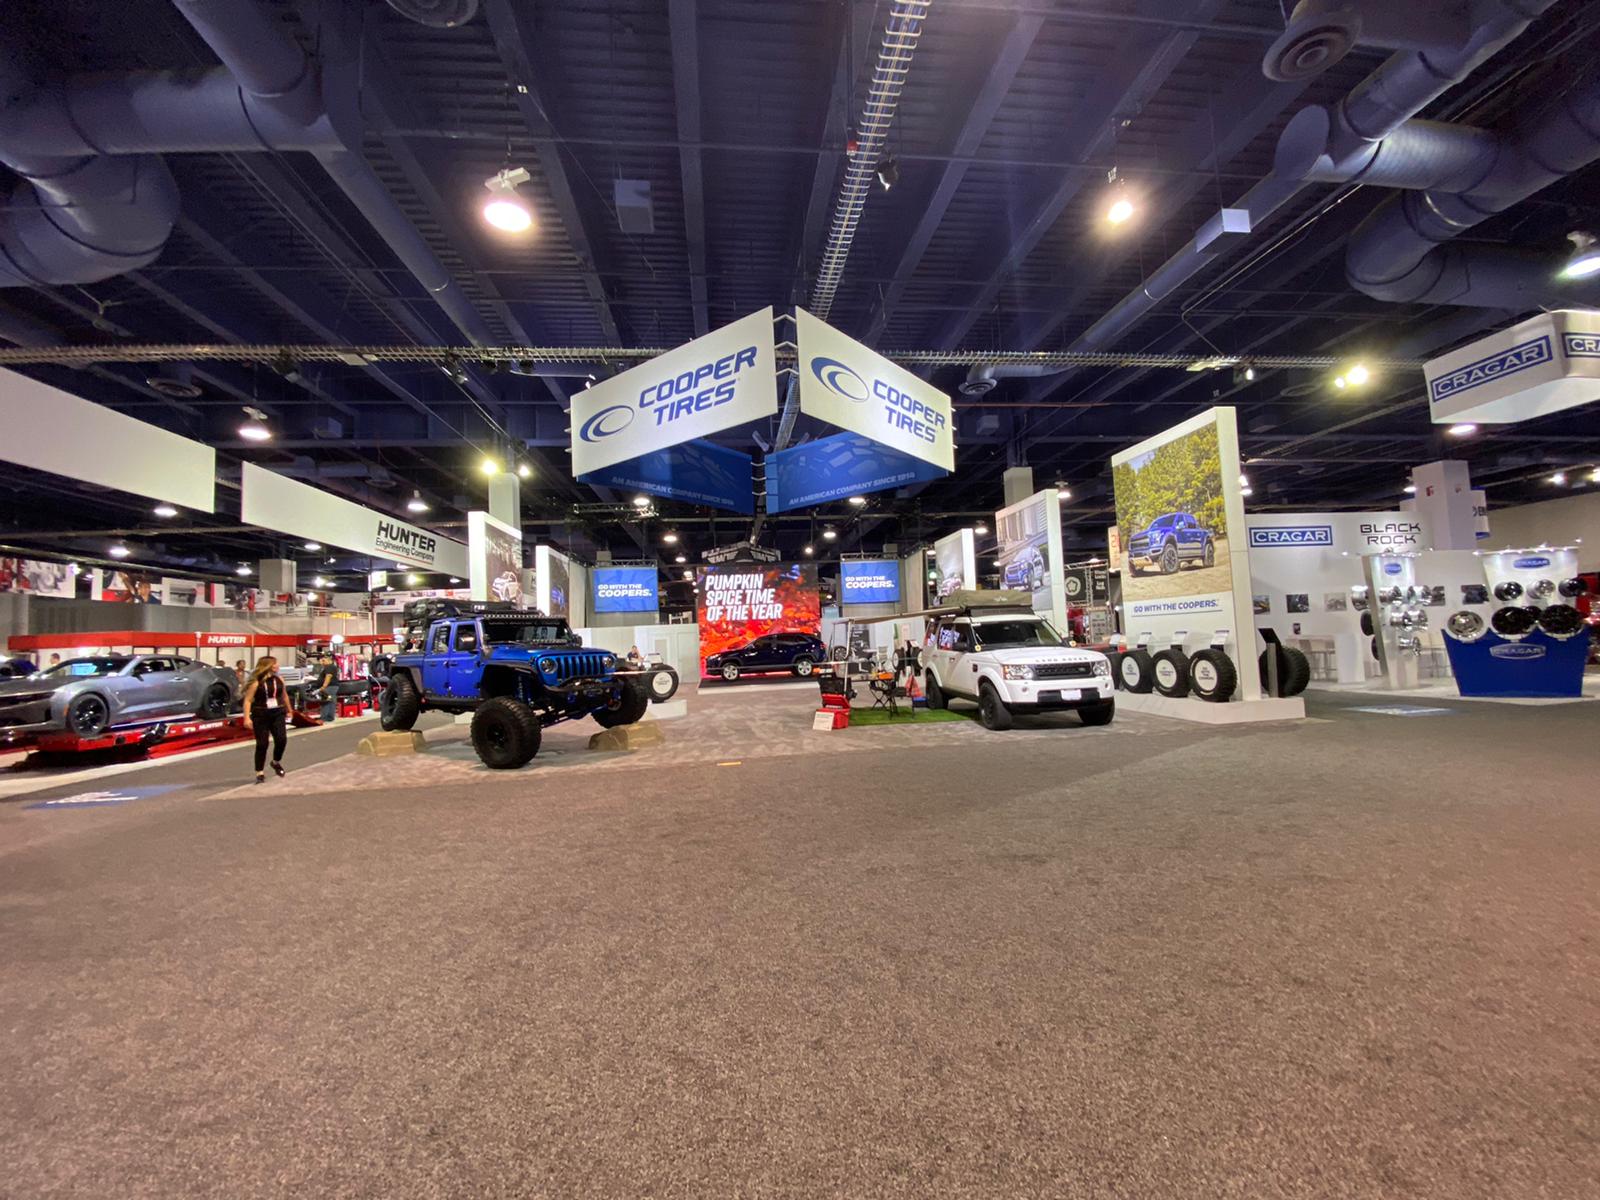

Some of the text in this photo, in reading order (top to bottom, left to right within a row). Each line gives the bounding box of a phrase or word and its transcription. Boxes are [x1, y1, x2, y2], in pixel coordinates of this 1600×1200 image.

[1571, 339, 1600, 352] CR
[638, 346, 758, 408] COOPER
[1437, 346, 1540, 393] CRAGAR
[653, 379, 737, 426] TIRES
[873, 379, 946, 430] COOPER
[885, 405, 936, 444] TIRES
[800, 489, 836, 503] AMERICAN
[836, 480, 873, 495] COMPANY
[377, 520, 437, 553] HUNTER
[1255, 530, 1327, 542] CRAGAR
[1359, 523, 1422, 534] BLACK
[1367, 535, 1417, 545] ROCK
[375, 537, 435, 562] Engineering Company
[704, 573, 764, 591] PUMPKIN
[705, 588, 776, 606] SPICE TIME
[706, 603, 784, 621] OF THE YEAR
[1133, 605, 1143, 613] GO
[1144, 603, 1162, 612] WITH
[1162, 602, 1177, 611] THE
[207, 635, 247, 644] HUNTER
